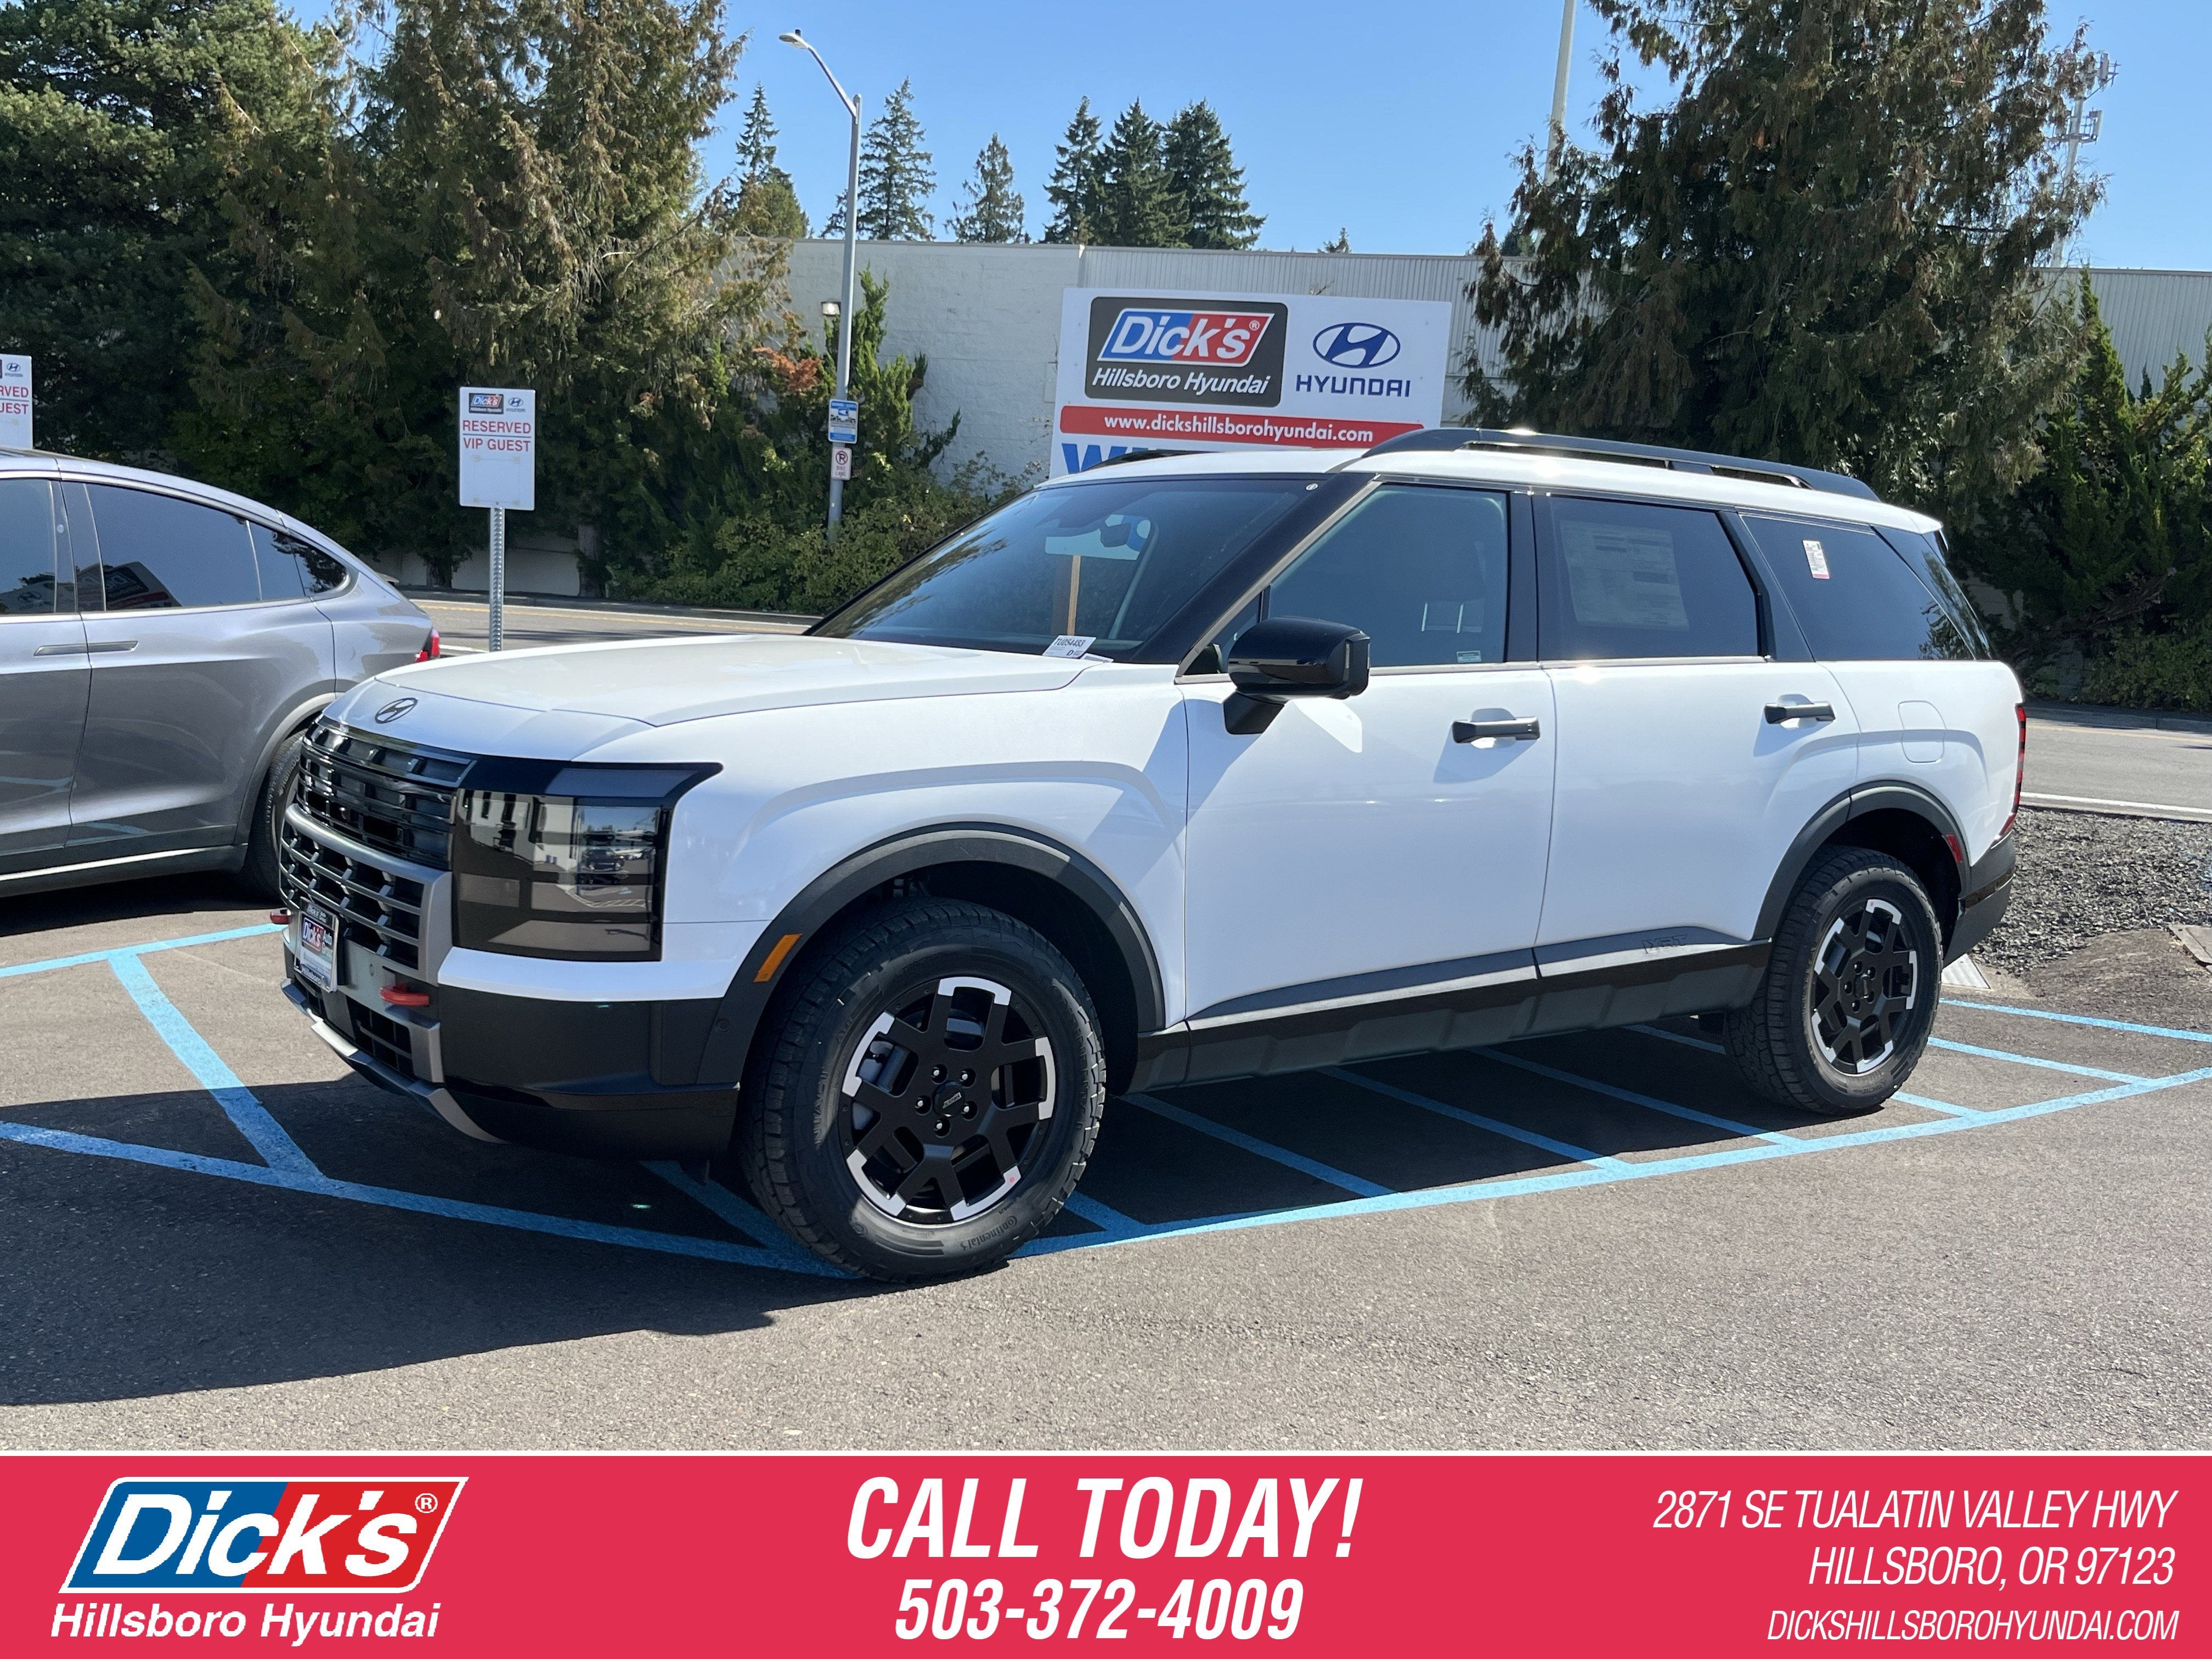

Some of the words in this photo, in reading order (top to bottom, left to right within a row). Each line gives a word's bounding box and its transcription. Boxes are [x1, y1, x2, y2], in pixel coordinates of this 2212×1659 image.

[1111, 316, 1250, 359] Dick's
[1092, 368, 1181, 388] Hillsboro
[1184, 372, 1271, 396] Hyundai
[1296, 375, 1410, 397] HYUNDAI
[462, 420, 531, 433] RESERVED
[1104, 414, 1373, 442] www.dickshillsborohyundai.com
[463, 438, 483, 449] VIP
[487, 438, 531, 452] GUEST
[967, 1215, 1018, 1250] Continental
